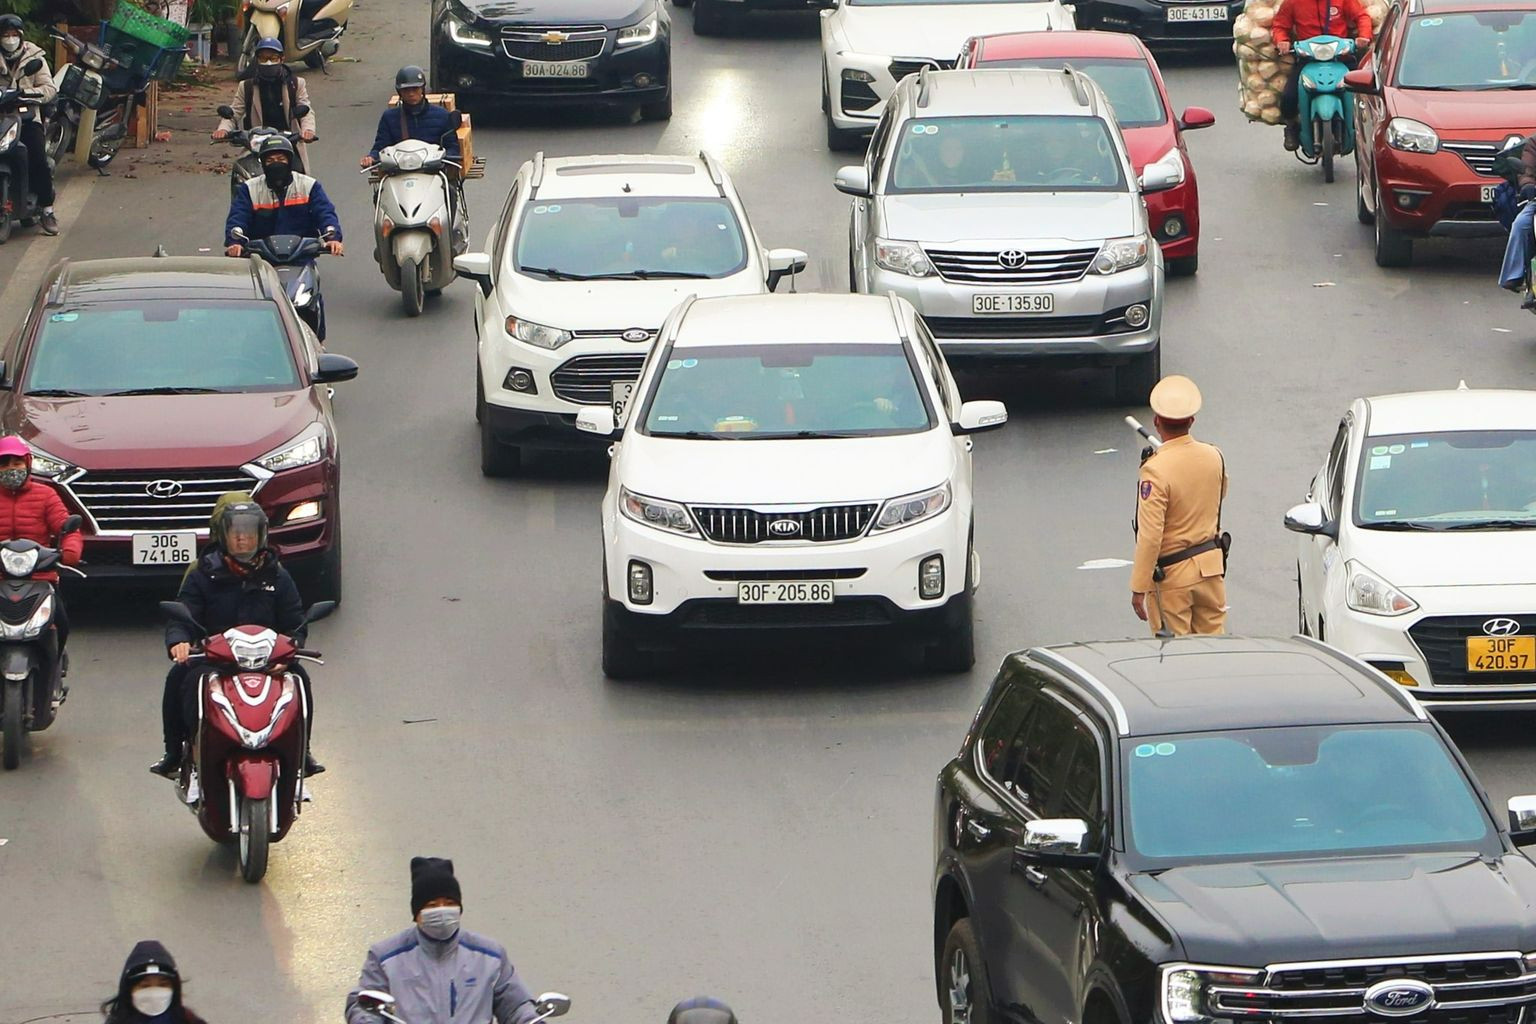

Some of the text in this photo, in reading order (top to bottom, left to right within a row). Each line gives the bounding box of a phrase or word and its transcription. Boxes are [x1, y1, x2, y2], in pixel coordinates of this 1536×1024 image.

[976, 296, 1050, 311] 30E-135.90
[774, 522, 795, 532] KIA
[151, 535, 178, 548] 30G
[140, 549, 190, 563] 741.86
[741, 584, 830, 601] 30F-205.86
[1487, 639, 1516, 653] 30F
[1475, 655, 1528, 669] 420.97
[1385, 991, 1418, 1006] Ford
